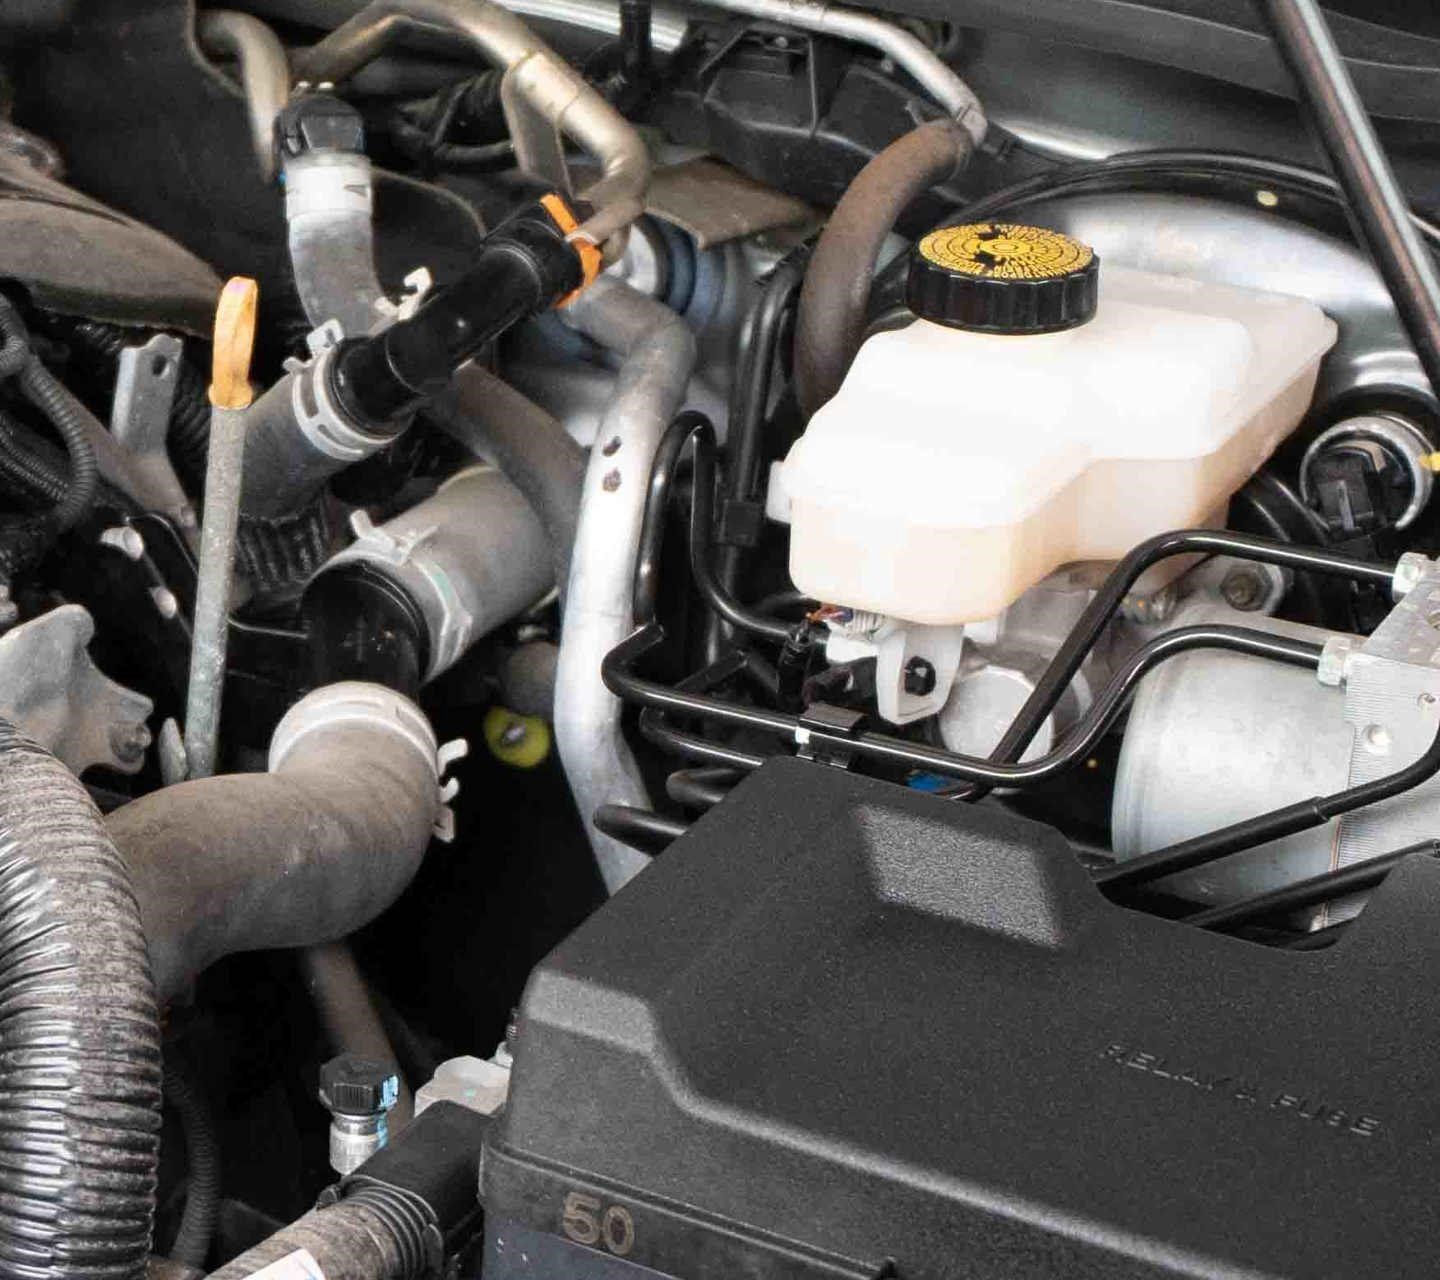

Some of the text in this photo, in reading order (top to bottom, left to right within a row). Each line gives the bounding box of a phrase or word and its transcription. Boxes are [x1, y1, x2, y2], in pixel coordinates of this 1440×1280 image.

[1100, 1044, 1232, 1090] RELAY
[1270, 1093, 1382, 1137] FUSE
[562, 1191, 636, 1256] 50
